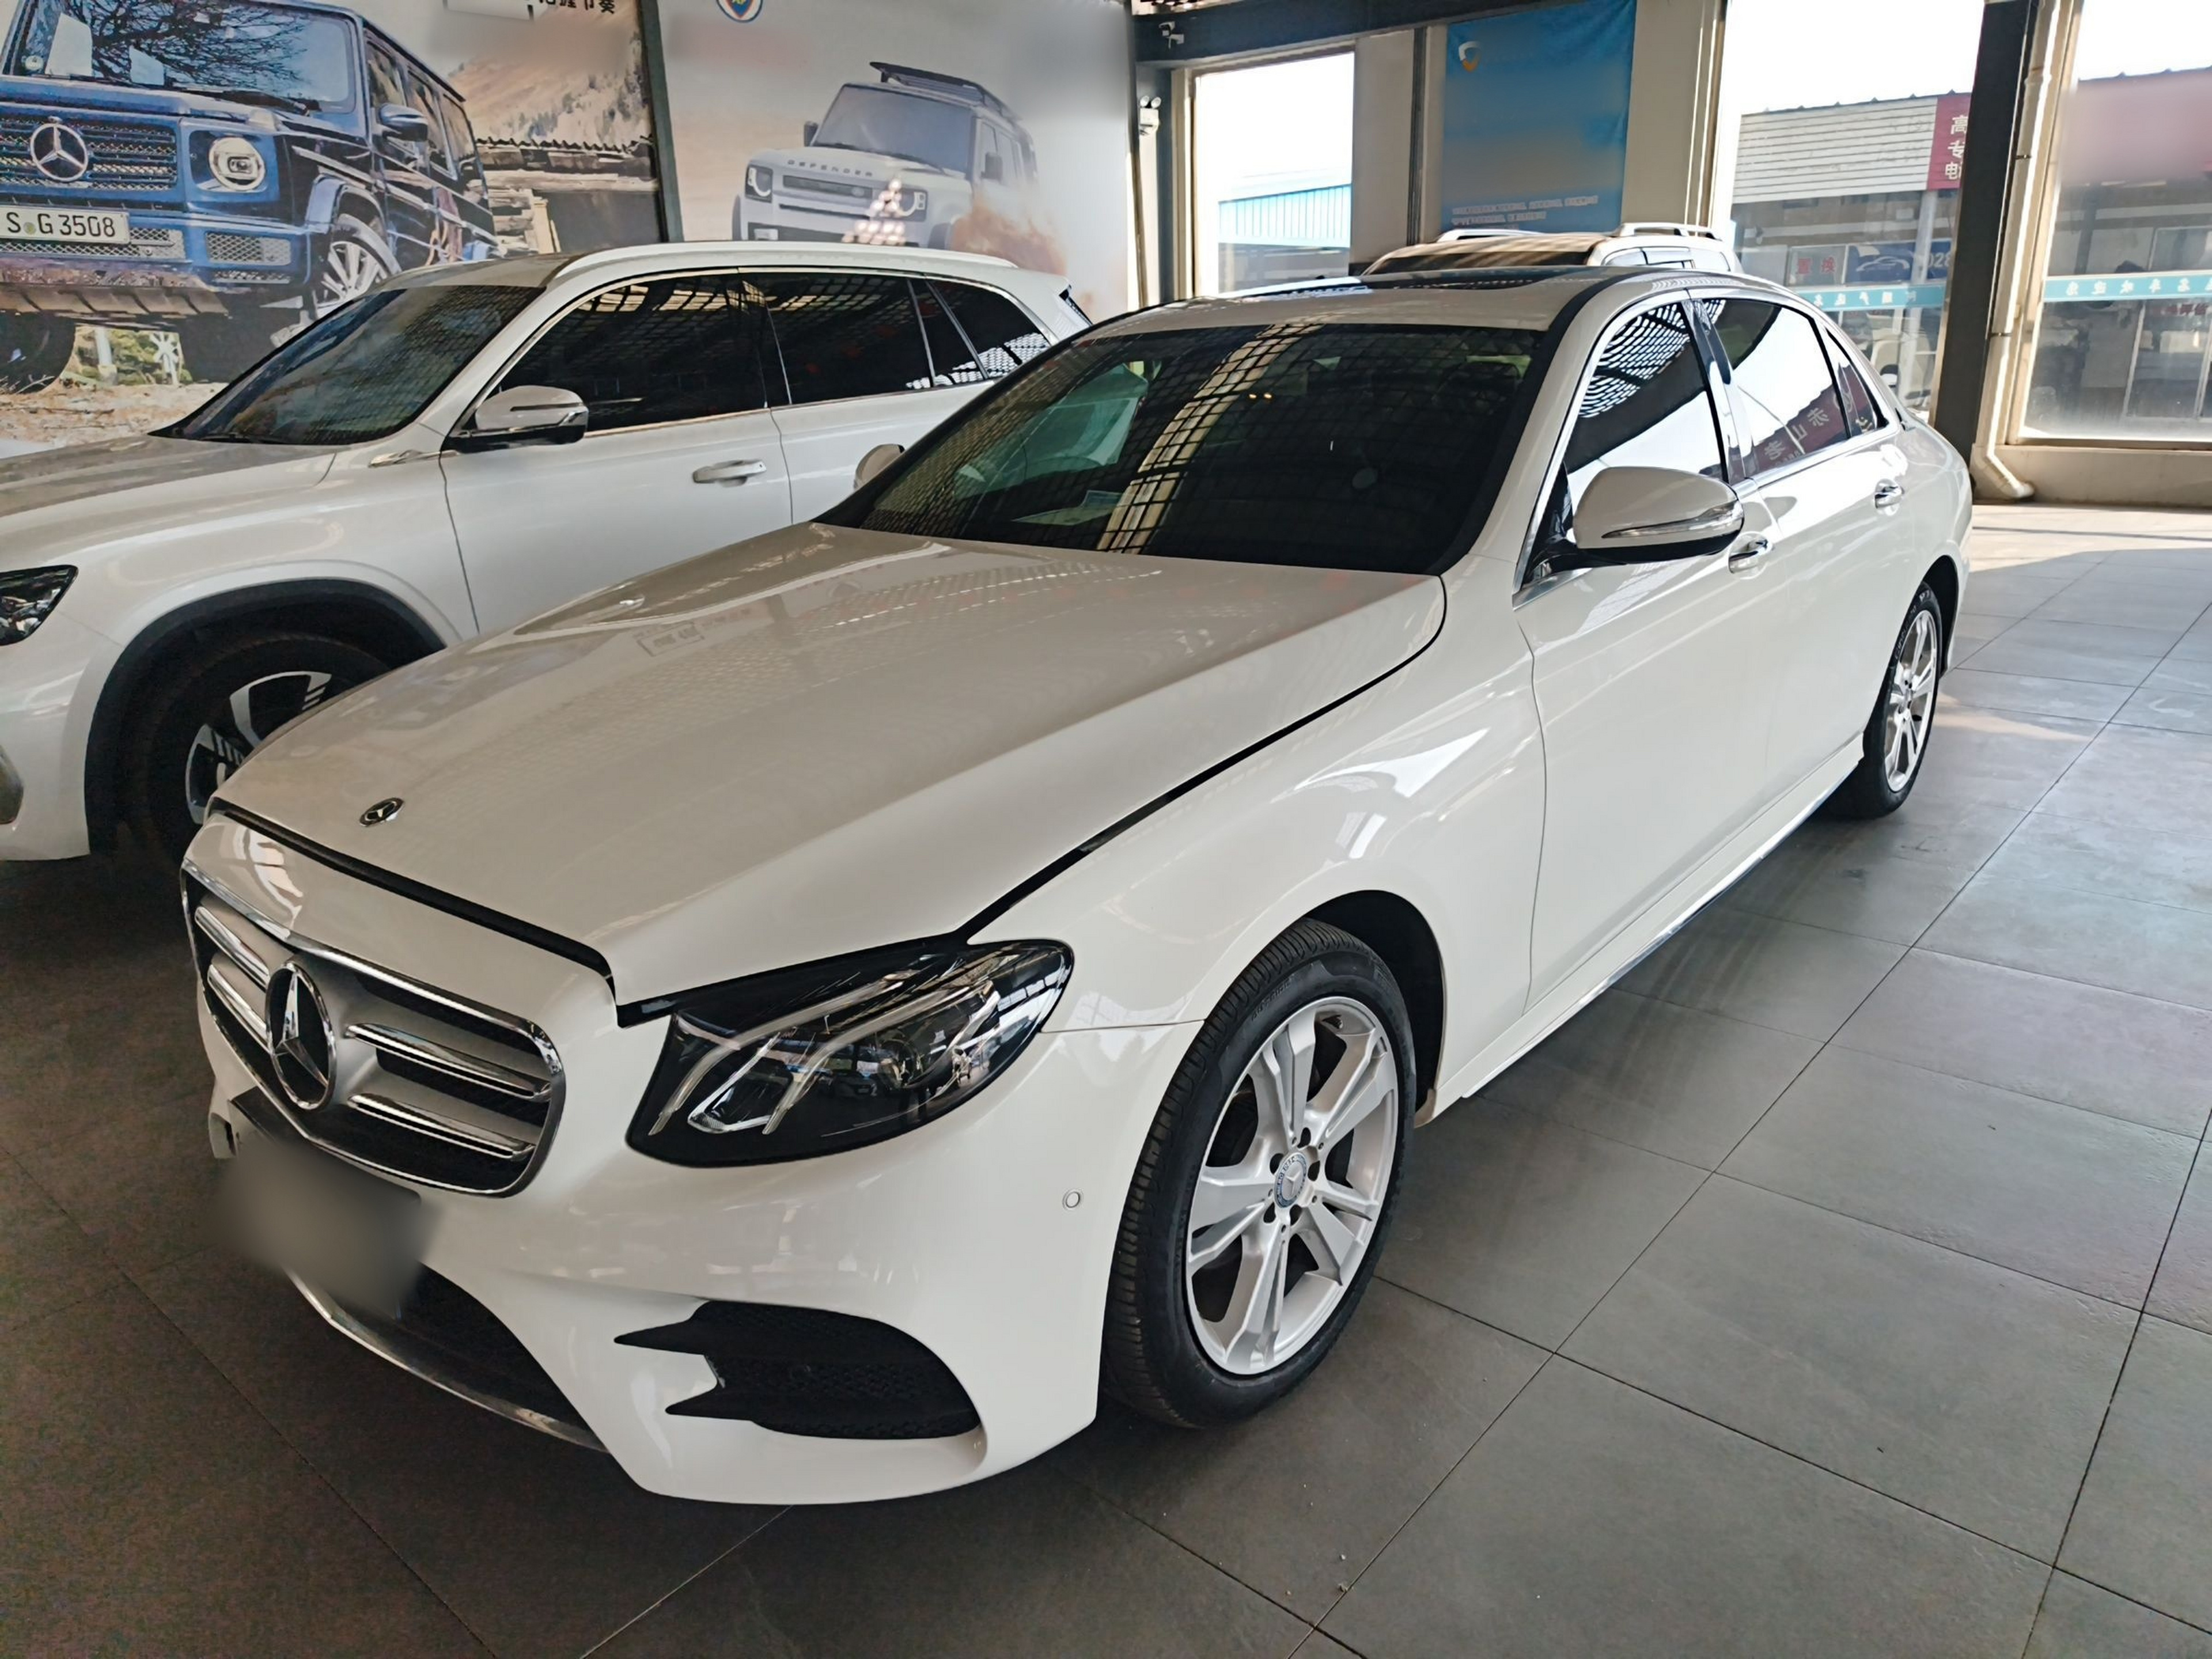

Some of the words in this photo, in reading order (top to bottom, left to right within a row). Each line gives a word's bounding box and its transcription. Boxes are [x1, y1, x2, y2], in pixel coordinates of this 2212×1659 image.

[1950, 115, 1968, 135] 高
[1945, 162, 1962, 180] 电
[58, 214, 115, 237] 3508
